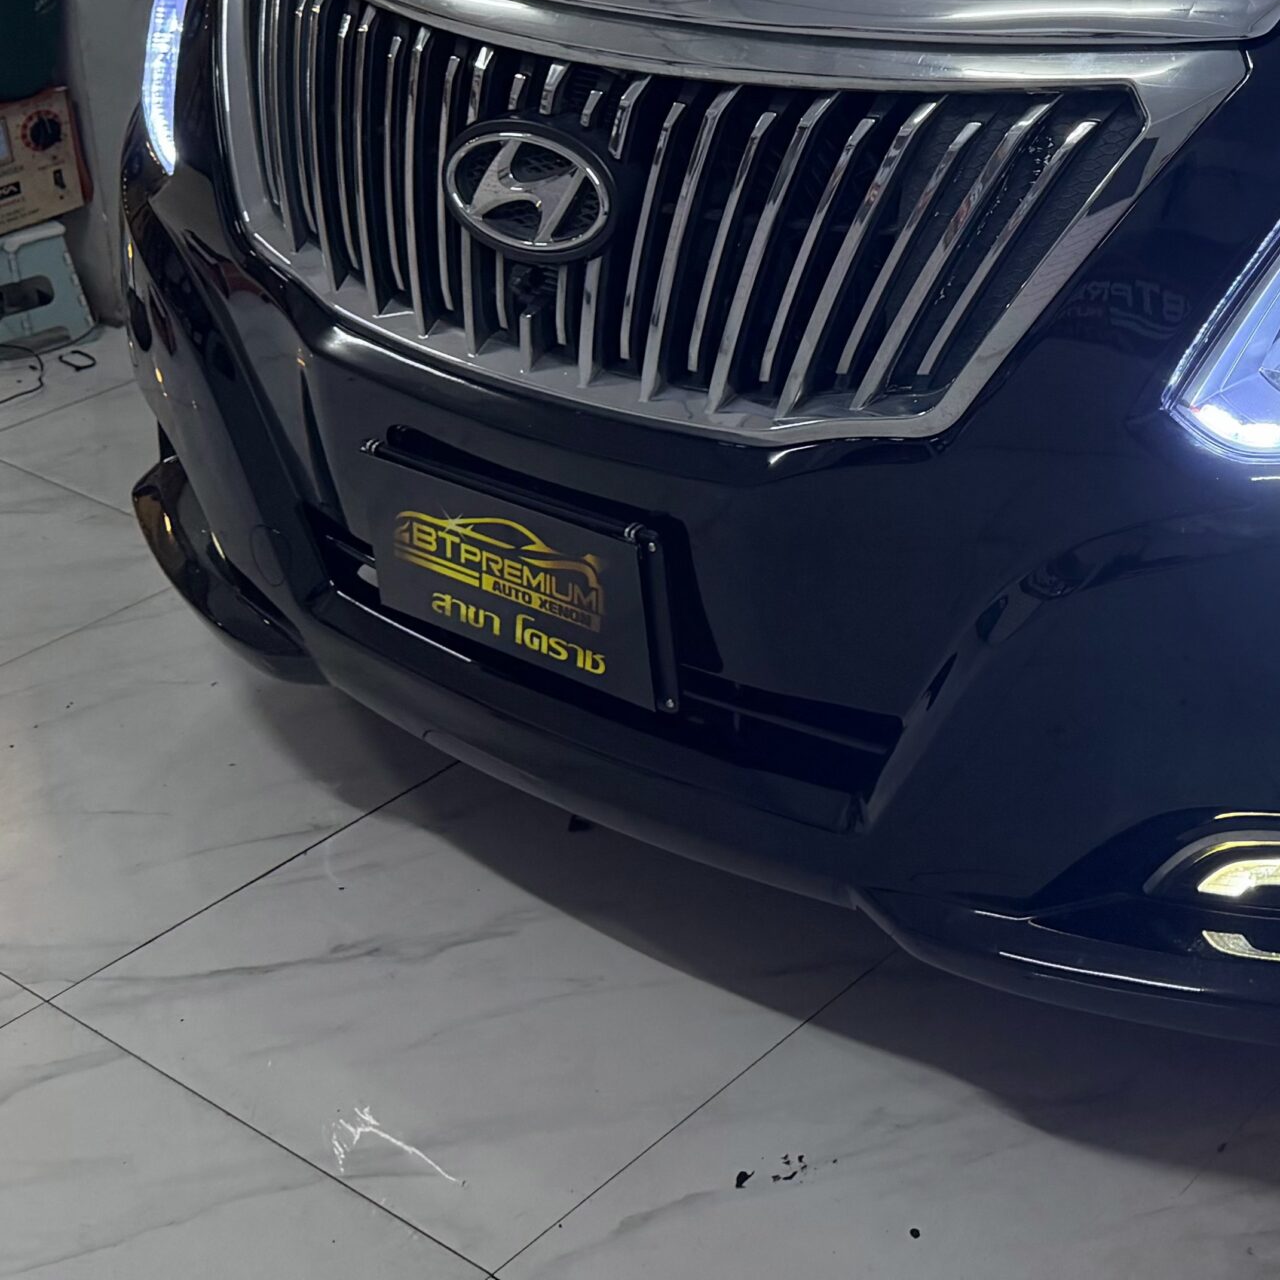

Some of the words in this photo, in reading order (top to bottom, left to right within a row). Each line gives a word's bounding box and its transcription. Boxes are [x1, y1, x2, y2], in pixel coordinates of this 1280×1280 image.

[431, 592, 500, 636] สาขา
[514, 613, 606, 675] โคราช
[492, 580, 533, 605] AUTO
[538, 597, 592, 627] XENON
